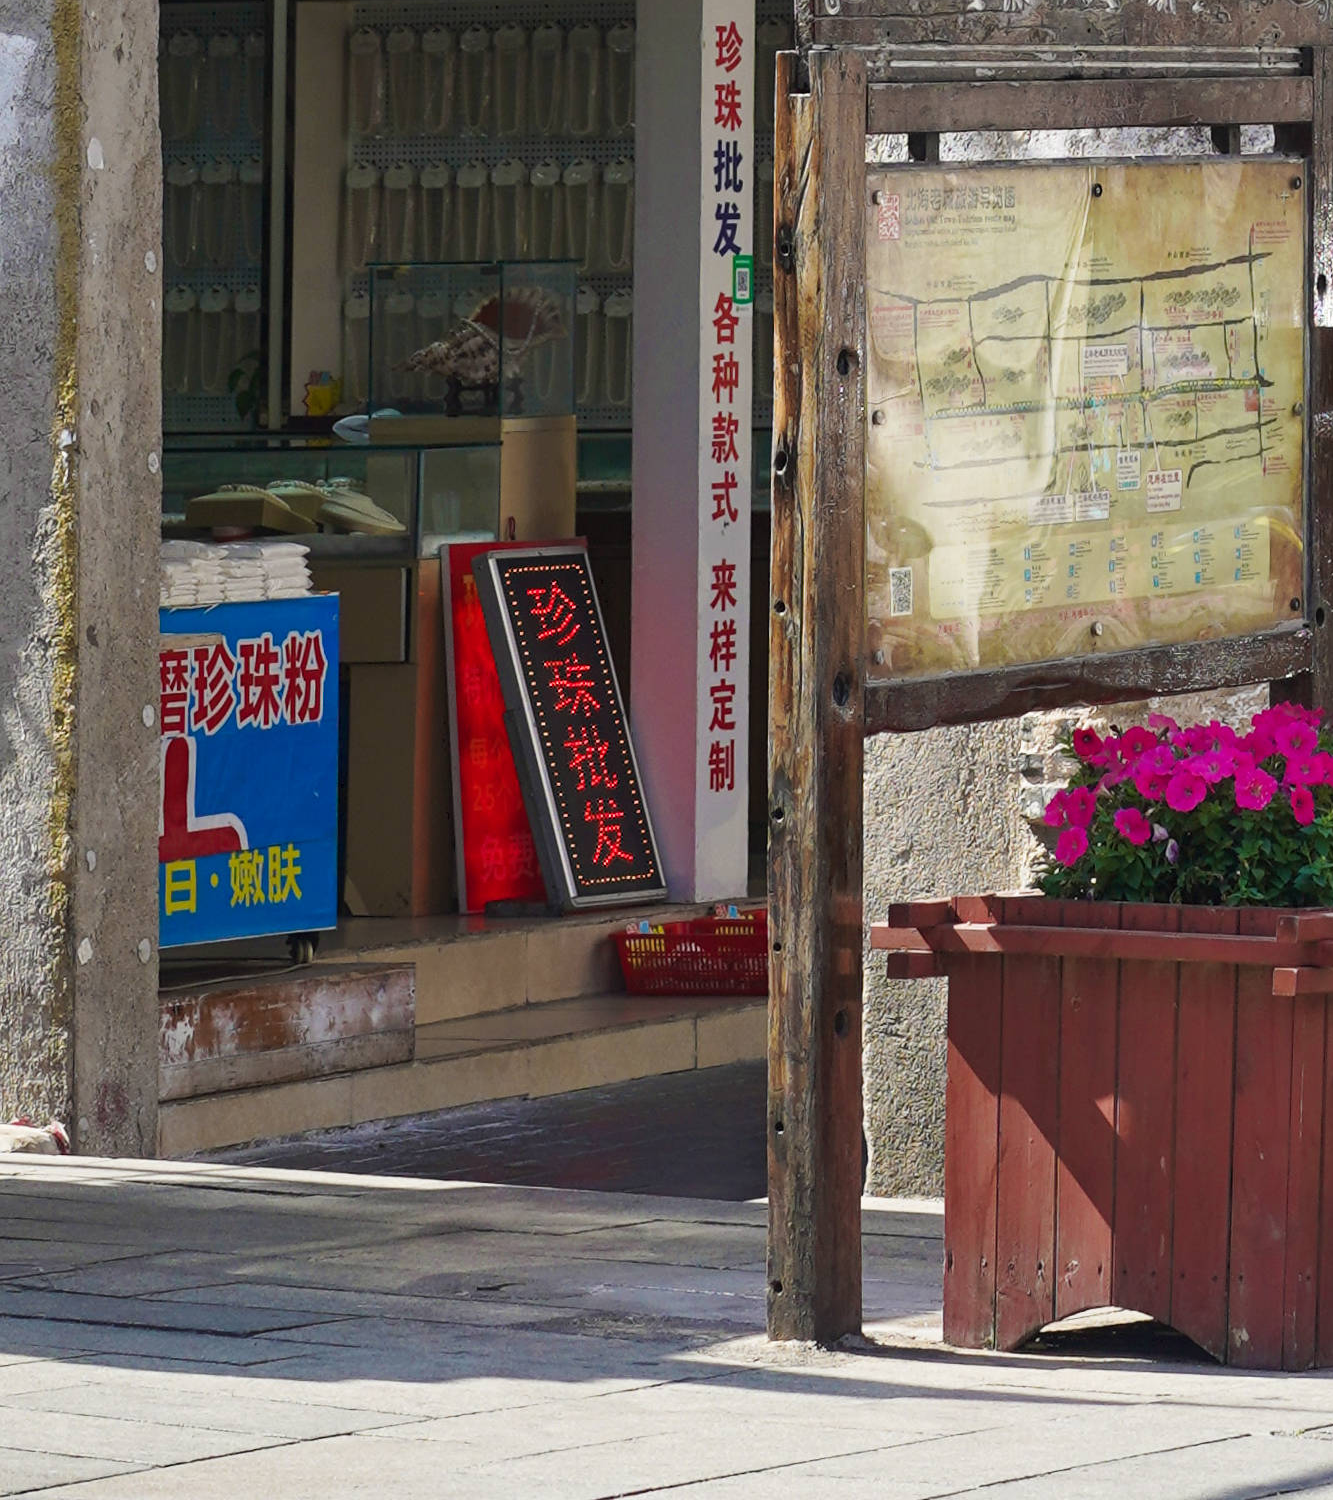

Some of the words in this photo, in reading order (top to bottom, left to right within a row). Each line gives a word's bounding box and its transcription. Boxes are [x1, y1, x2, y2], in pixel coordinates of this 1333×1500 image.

[712, 21, 744, 258] 珍珠批发
[710, 291, 741, 524] 各种款式
[526, 580, 635, 868] 珍珠批发
[707, 559, 740, 793] 来样定制
